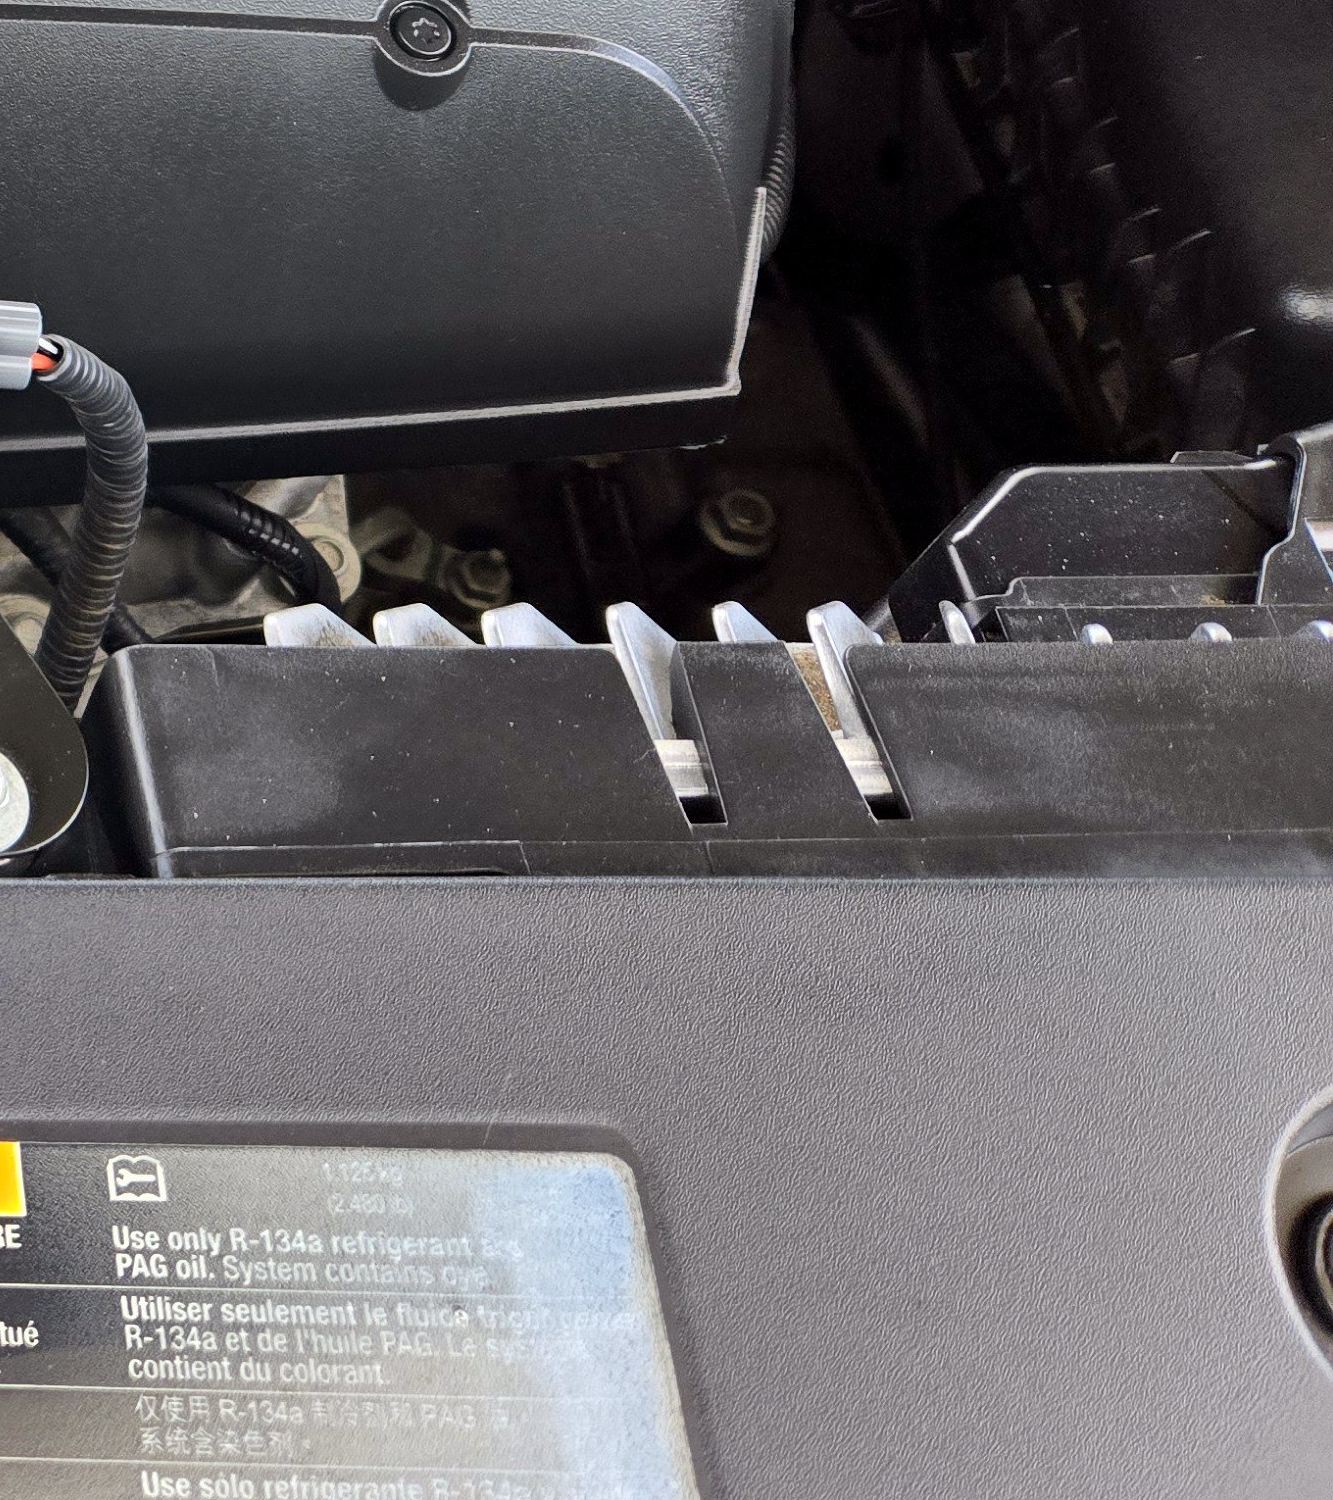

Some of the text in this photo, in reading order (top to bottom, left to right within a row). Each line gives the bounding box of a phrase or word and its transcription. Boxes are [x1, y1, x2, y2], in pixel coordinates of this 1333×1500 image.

[111, 1225, 160, 1251] Use
[167, 1227, 221, 1256] only
[229, 1228, 323, 1254] R-134a
[330, 1230, 472, 1264] refrigerant
[115, 1253, 169, 1279] PAG
[175, 1254, 215, 1280] oil.
[222, 1255, 318, 1285] System
[324, 1261, 436, 1286] contains
[120, 1295, 213, 1322] Utiliser
[220, 1299, 357, 1325] seulement
[364, 1301, 387, 1326] le
[396, 1301, 469, 1328] fluide
[124, 1324, 217, 1351] R-134a
[225, 1328, 251, 1352] et
[257, 1328, 288, 1353] de
[295, 1328, 374, 1355] l'huile
[128, 1355, 390, 1385] contient du colorant.
[134, 1394, 211, 1424] 仅使用
[219, 1399, 304, 1425] R-134a
[141, 1470, 191, 1499] Use
[263, 1474, 423, 1500] refrigerante
